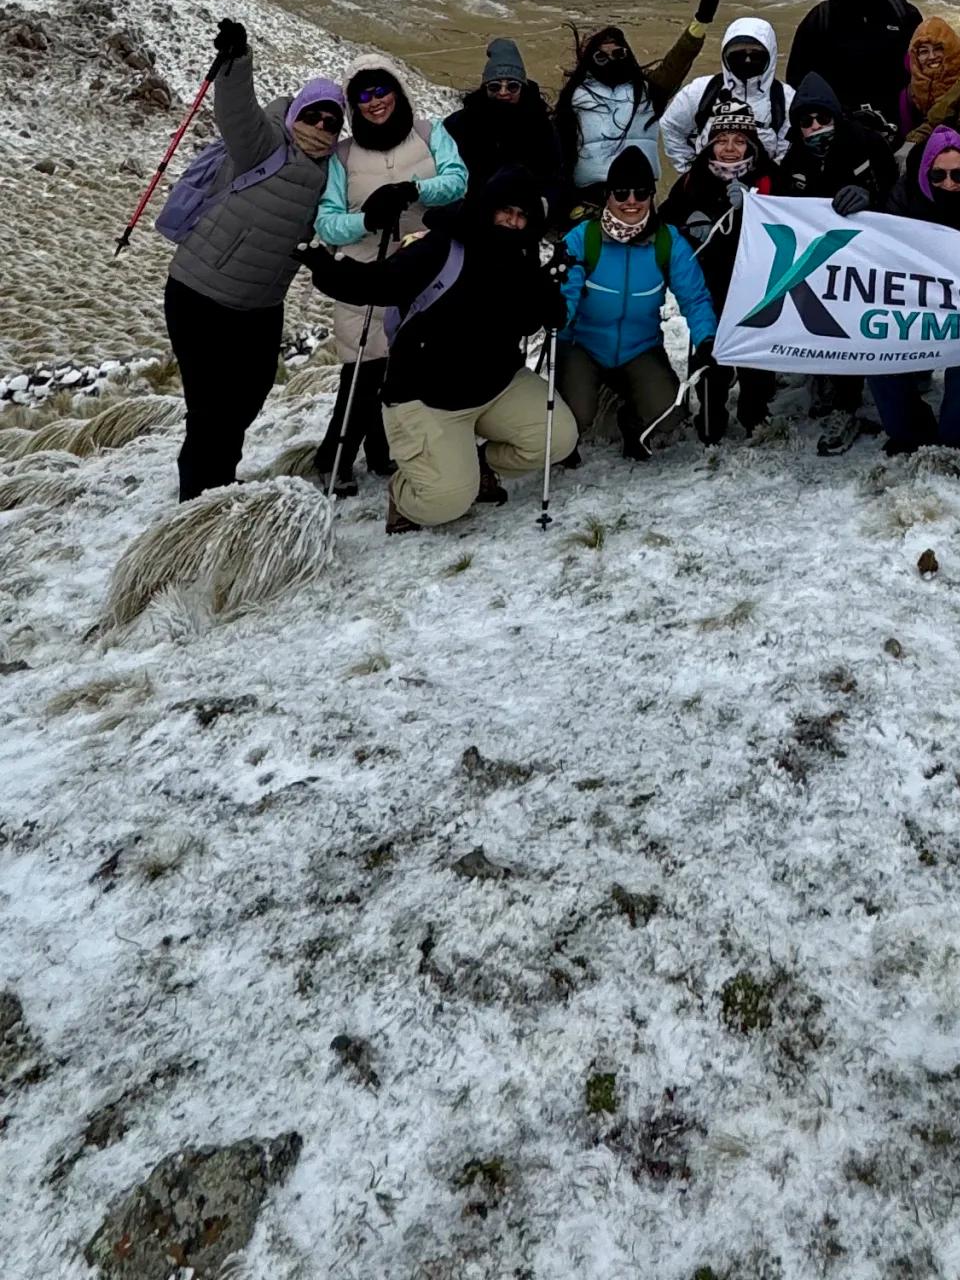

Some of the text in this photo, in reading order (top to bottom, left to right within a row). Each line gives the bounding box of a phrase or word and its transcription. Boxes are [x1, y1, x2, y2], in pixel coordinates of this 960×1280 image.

[859, 308, 960, 341] GYM
[770, 344, 942, 361] ENTRENAMIENTO INTEGRAL
